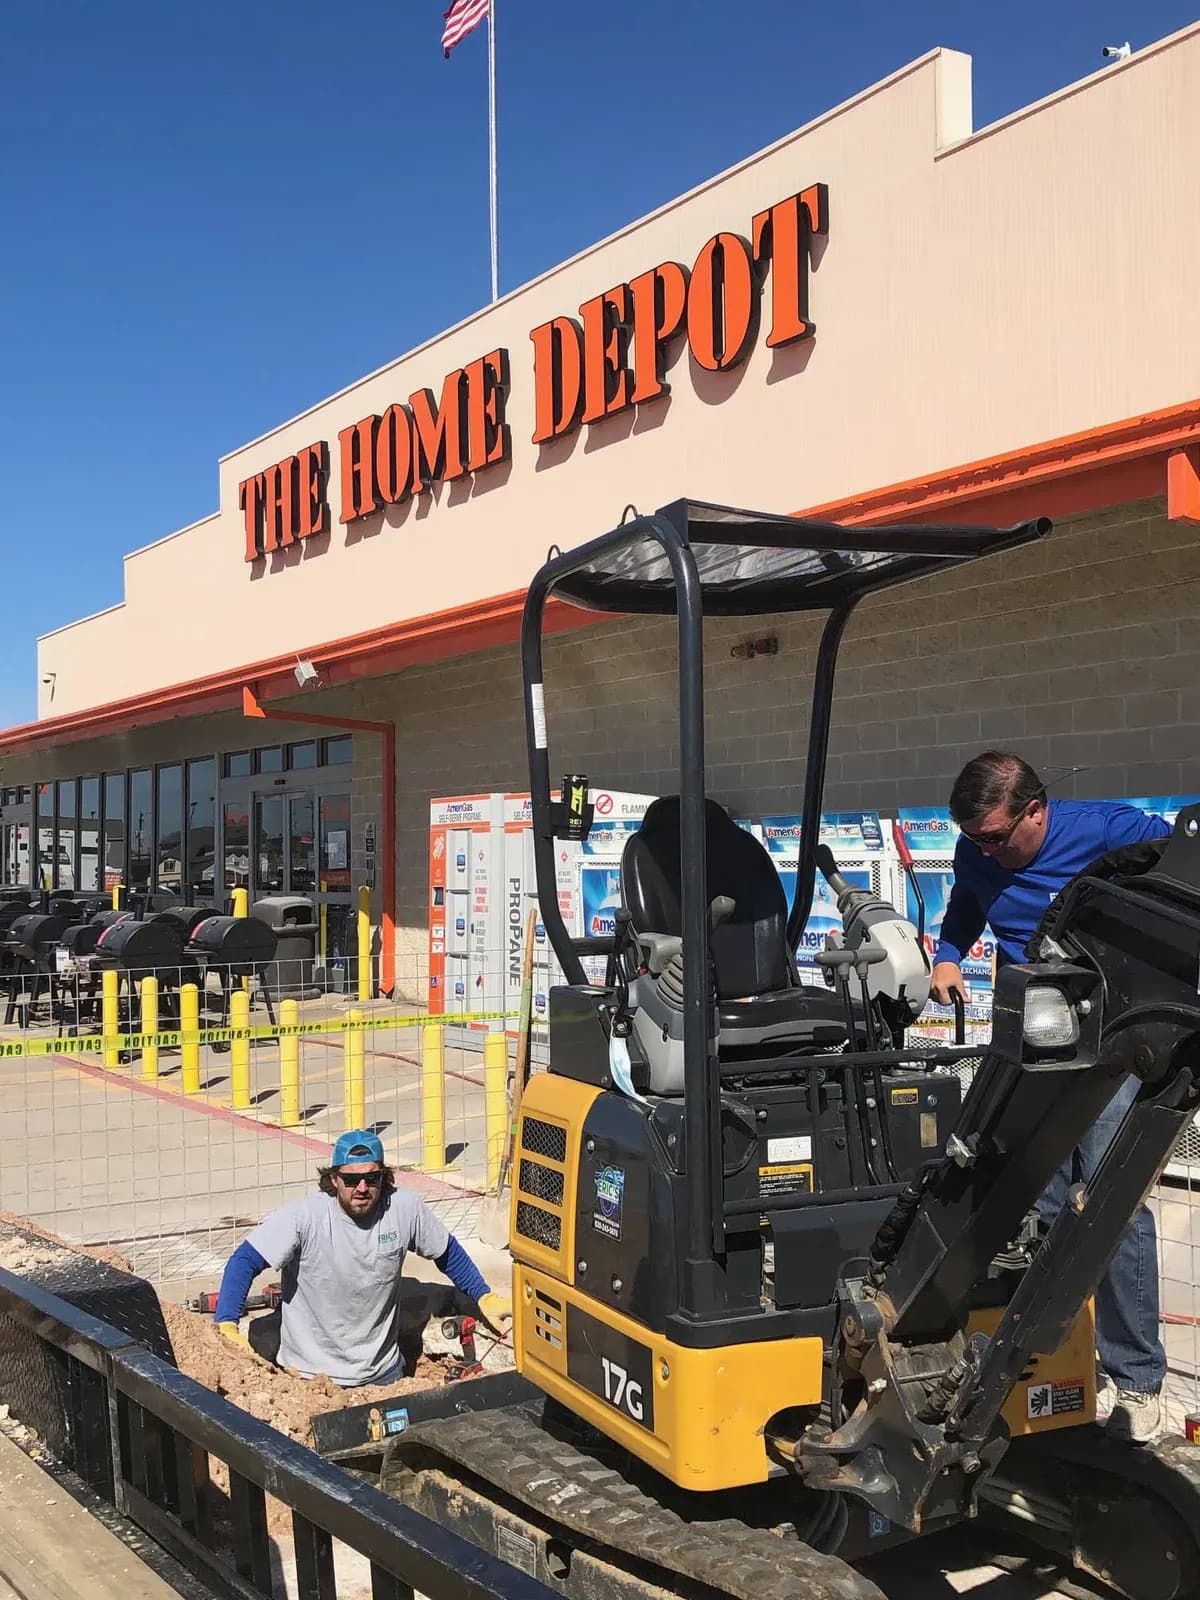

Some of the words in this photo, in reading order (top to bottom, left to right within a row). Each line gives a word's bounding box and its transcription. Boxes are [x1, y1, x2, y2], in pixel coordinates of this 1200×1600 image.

[239, 440, 328, 563] THE
[338, 348, 510, 524] HOME
[529, 183, 828, 446] DEPOT
[904, 820, 949, 833] AmeriGas
[509, 877, 521, 987] PROPANE
[602, 1357, 643, 1420] 17G
